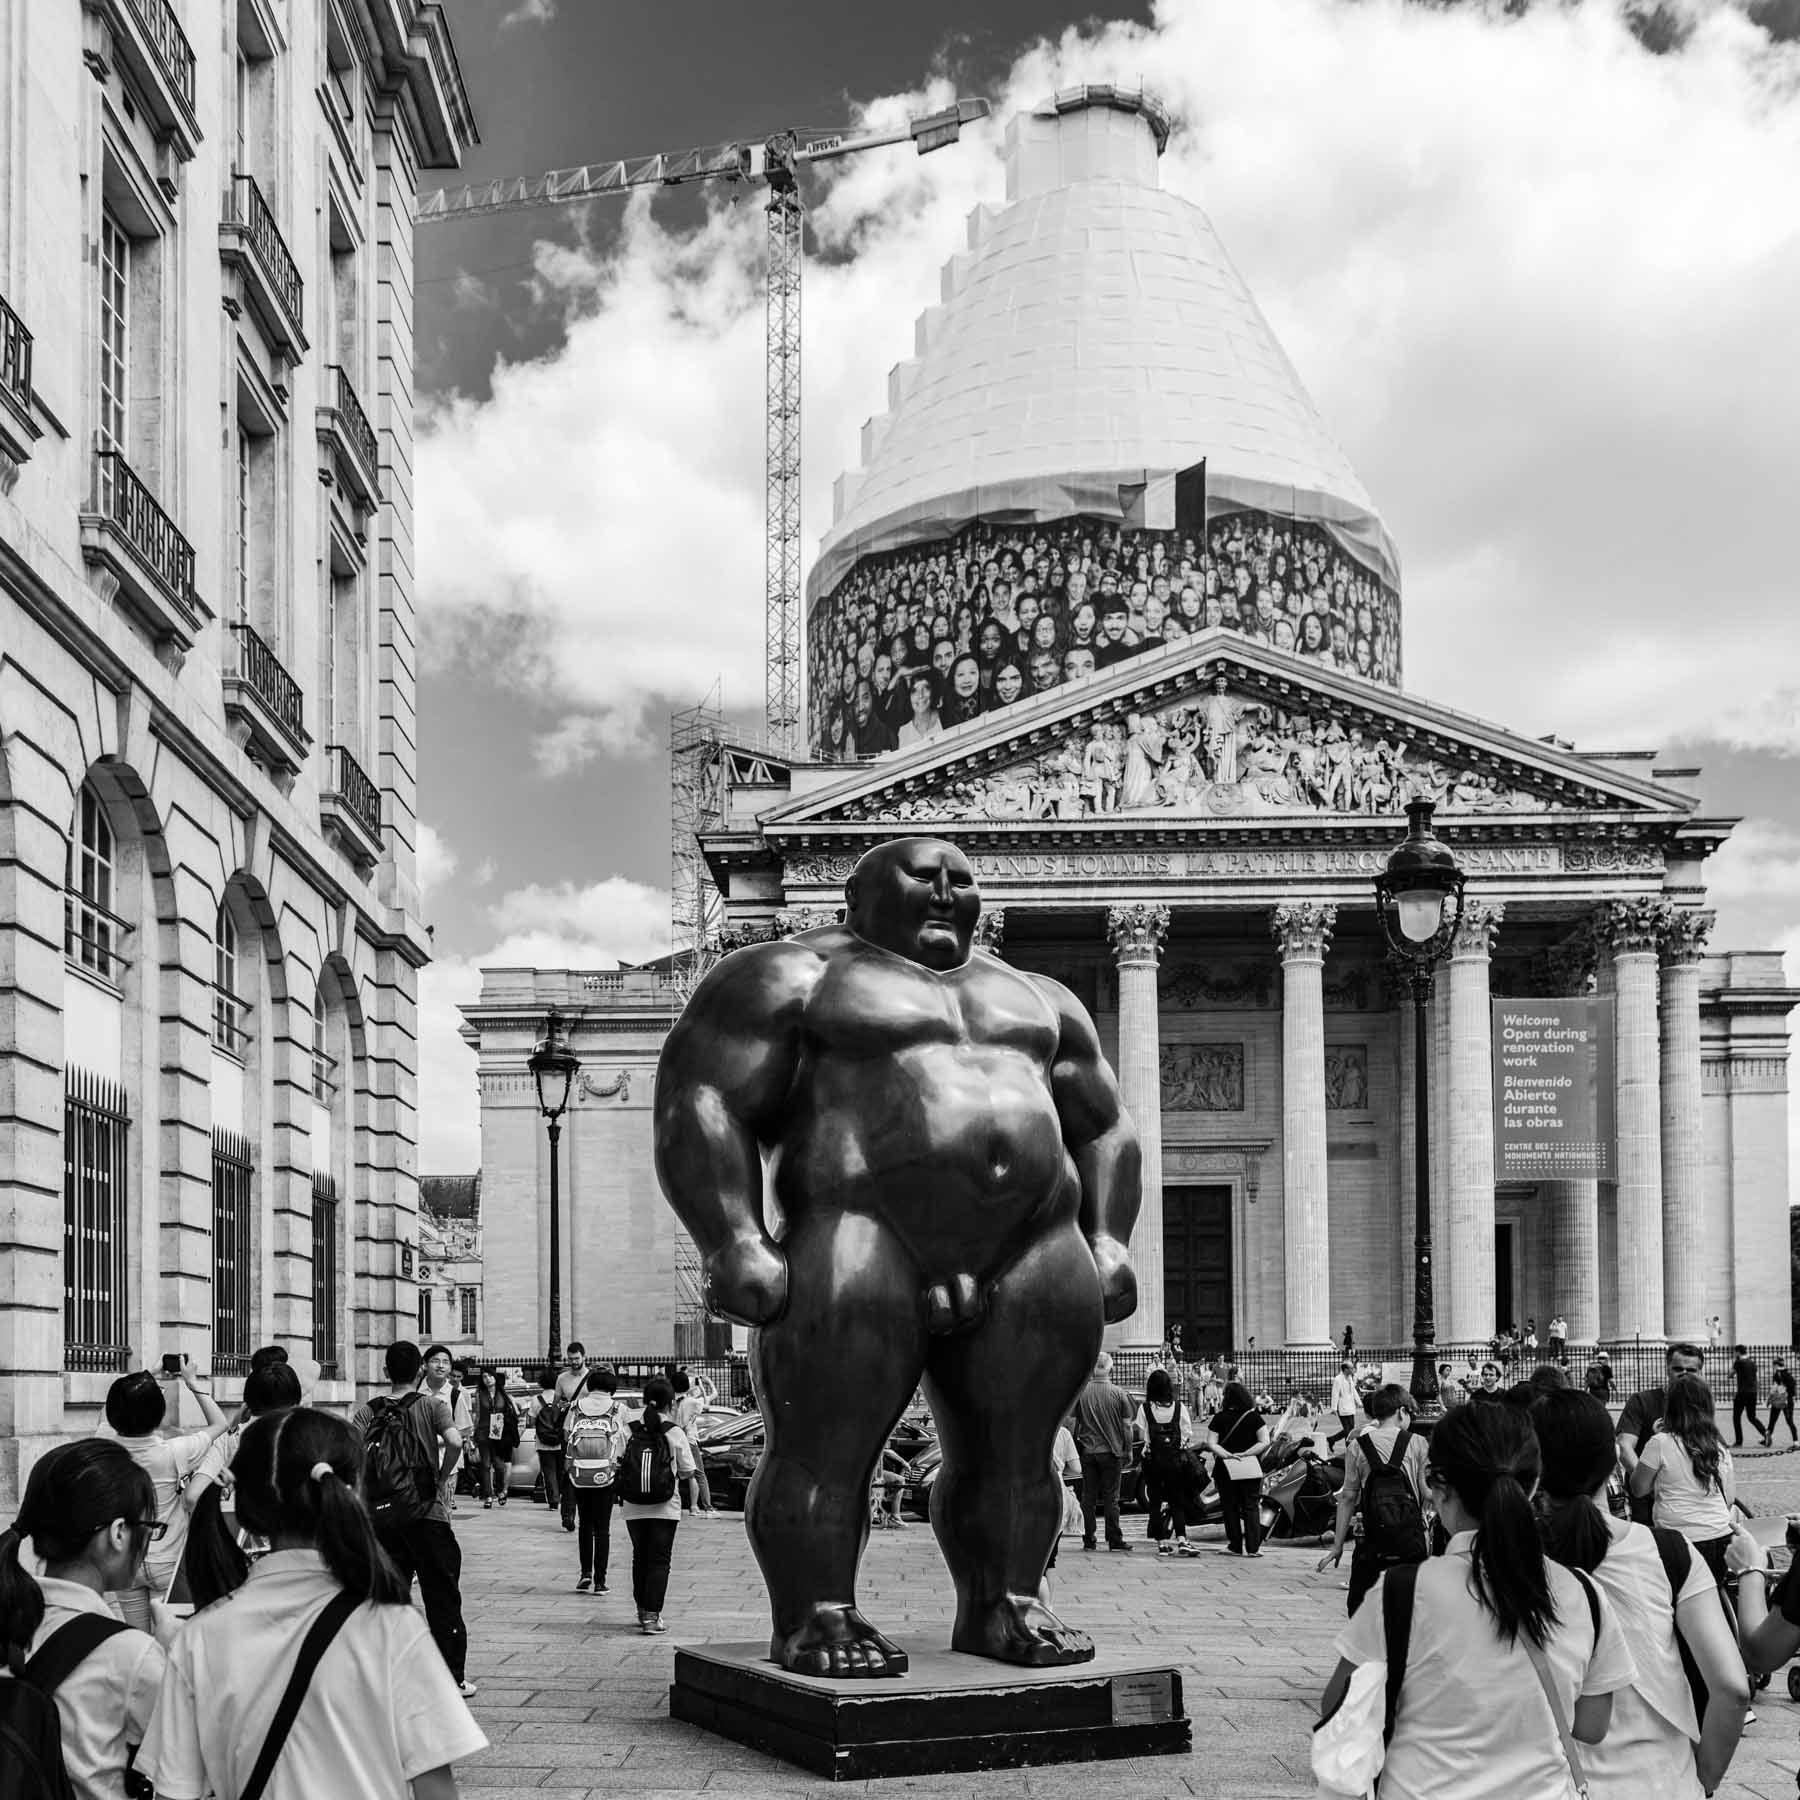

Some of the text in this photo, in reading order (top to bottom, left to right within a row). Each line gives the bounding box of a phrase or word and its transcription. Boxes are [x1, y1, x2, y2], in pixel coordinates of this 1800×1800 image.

[1062, 855, 1170, 876] HOMMES
[1186, 854, 1217, 874] LA
[1225, 853, 1317, 873] PATRIE
[1503, 1014, 1561, 1026] Welcome
[1503, 1028, 1588, 1042] Open during
[1503, 1041, 1575, 1053] renovation
[1503, 1055, 1537, 1067] work
[1504, 1075, 1573, 1087] Bienvenido
[1504, 1089, 1557, 1101] Abierto
[1504, 1103, 1557, 1114] durante
[1504, 1116, 1564, 1128] las obras
[1504, 1143, 1532, 1151] CENTRE
